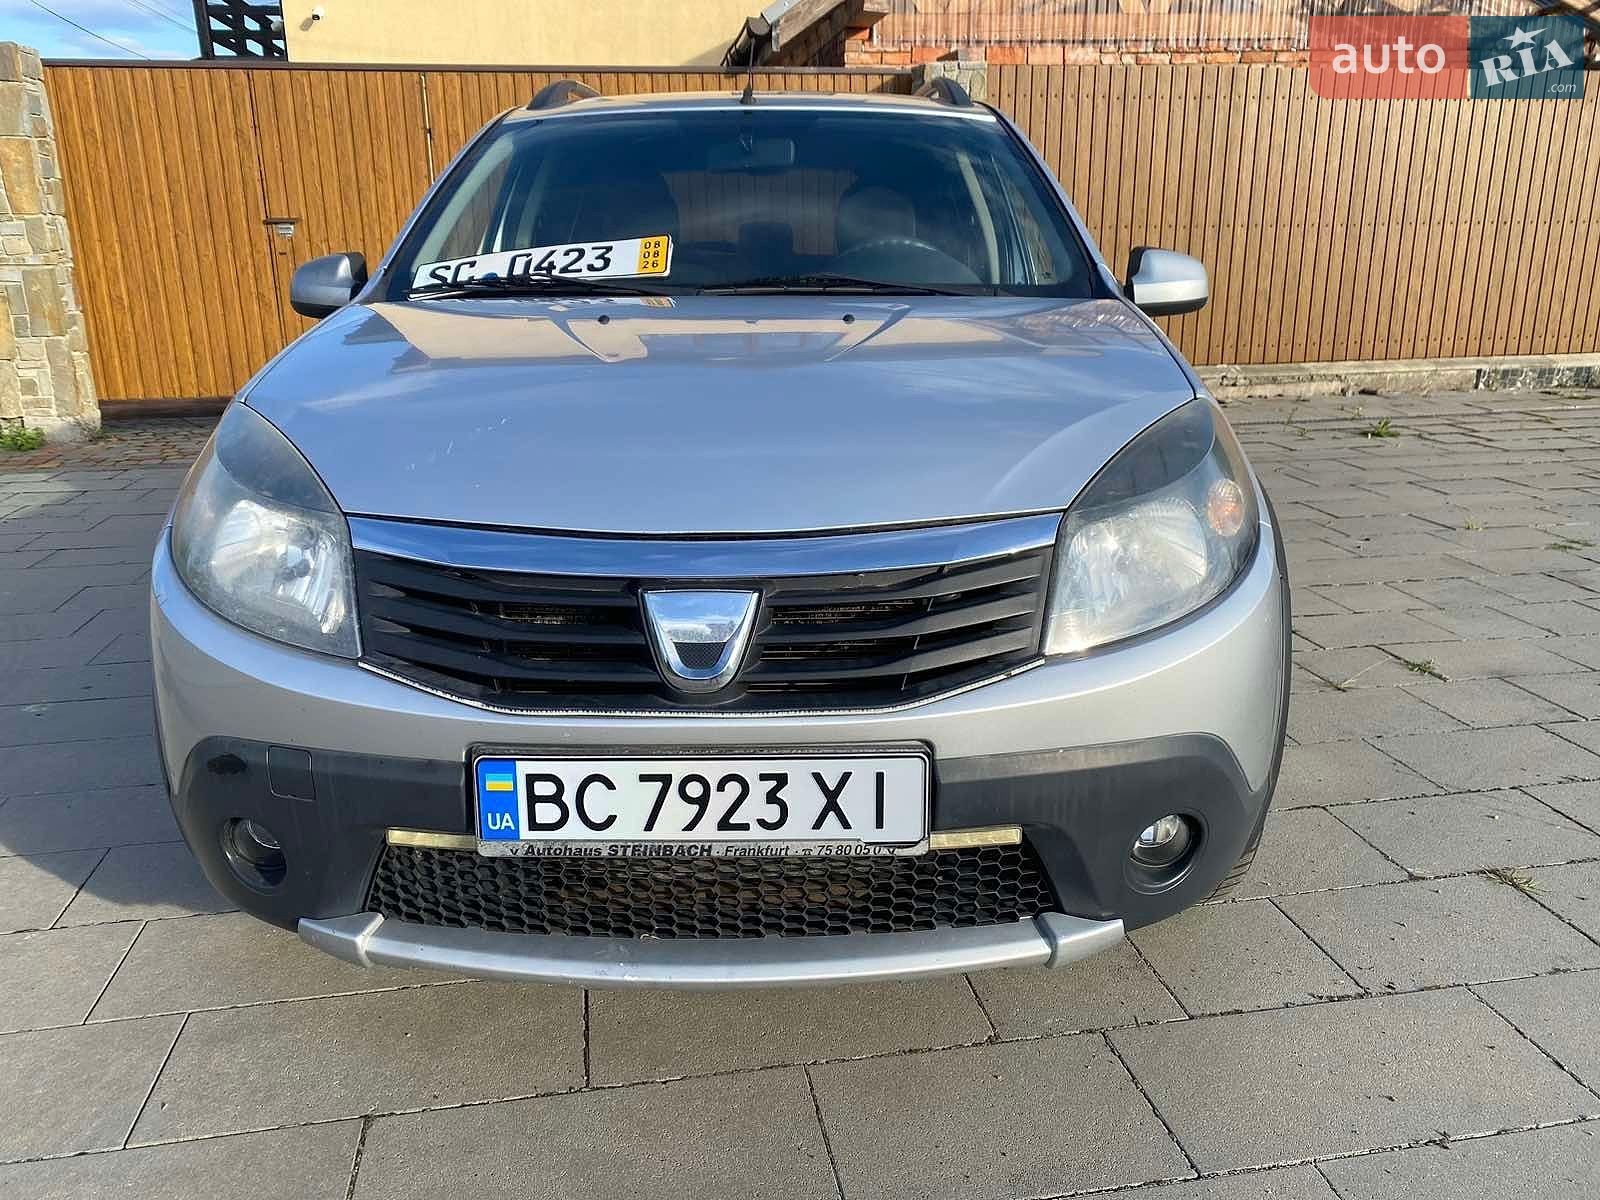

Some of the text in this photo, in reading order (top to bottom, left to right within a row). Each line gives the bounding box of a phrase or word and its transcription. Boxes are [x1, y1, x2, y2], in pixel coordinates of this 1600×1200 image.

[644, 240, 661, 250] 08
[642, 249, 660, 259] 08
[641, 259, 659, 269] 26
[525, 773, 618, 832] BC
[638, 772, 789, 832] 7923
[487, 812, 515, 830] UA
[524, 844, 602, 857] Autohaus
[607, 844, 712, 857] STEINBACH
[724, 845, 790, 857] Frankfurt
[817, 845, 833, 856] 75
[835, 845, 852, 856] 80
